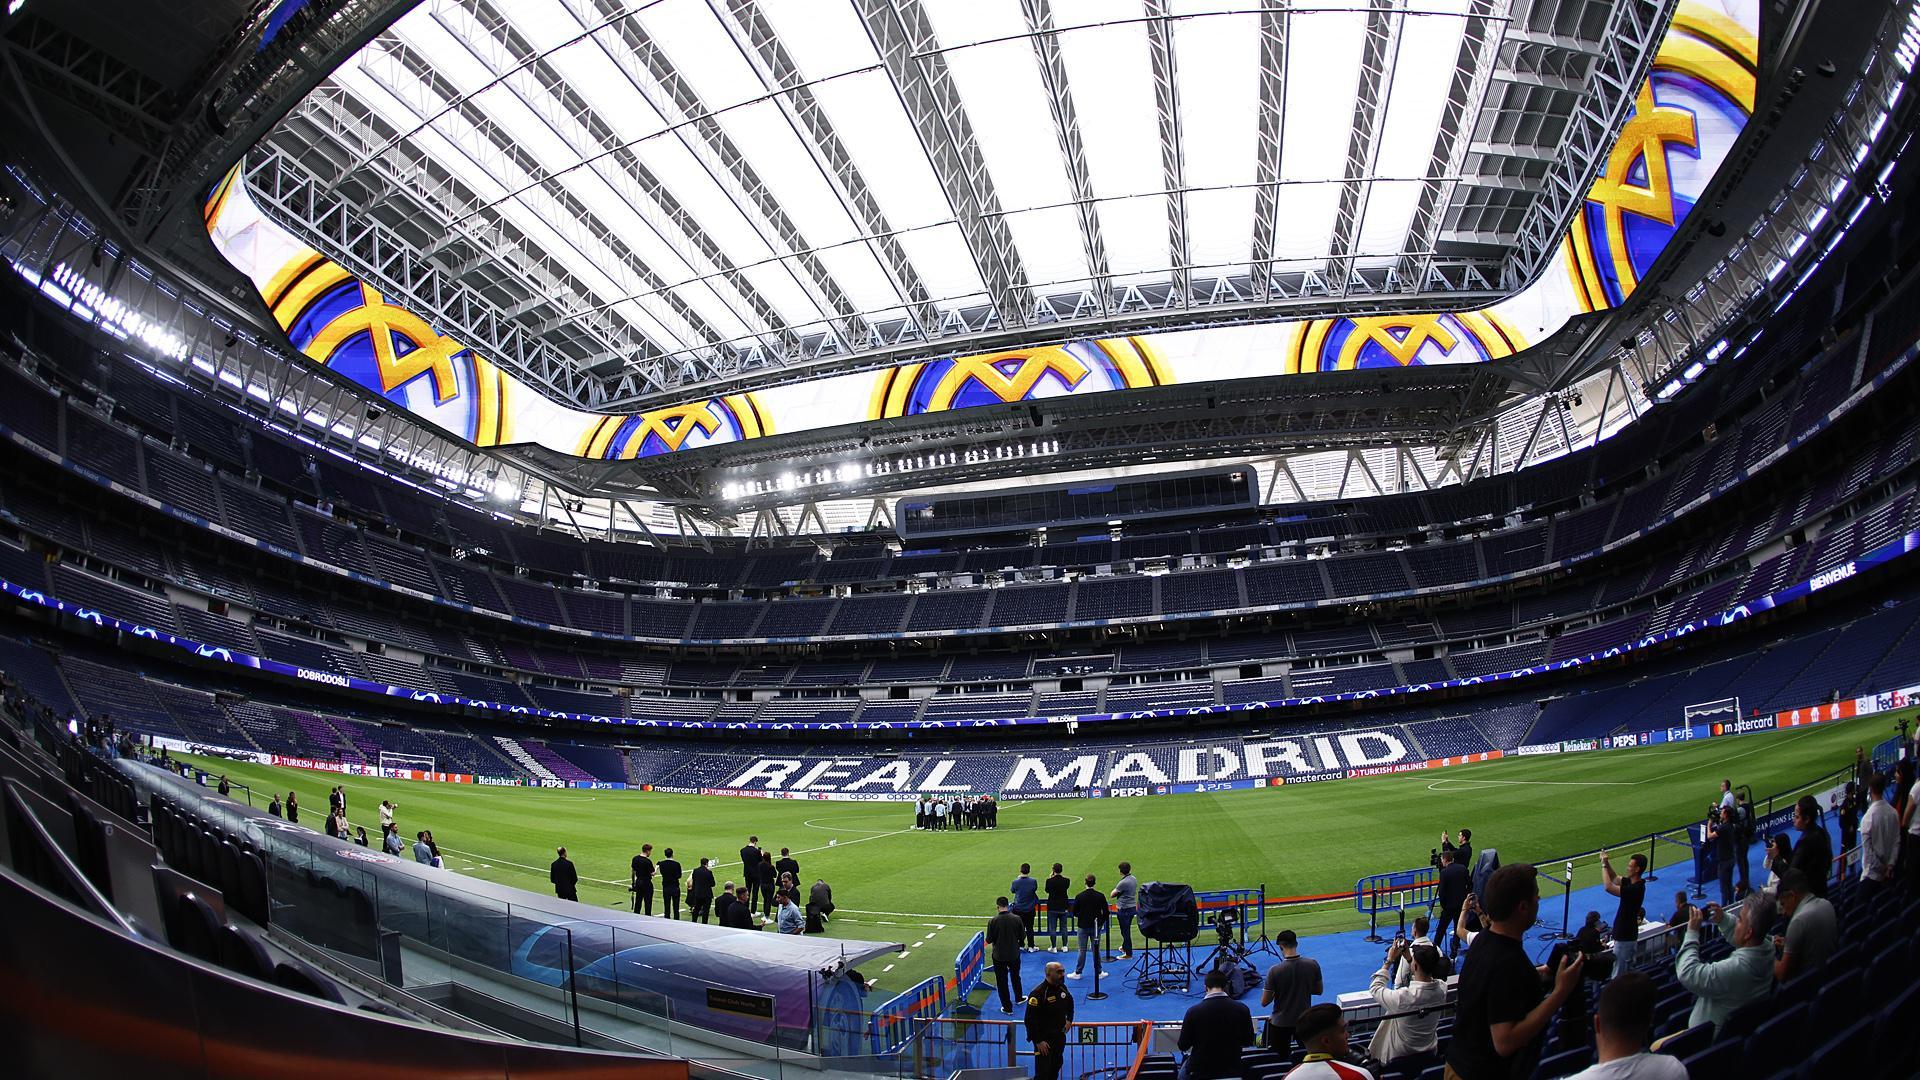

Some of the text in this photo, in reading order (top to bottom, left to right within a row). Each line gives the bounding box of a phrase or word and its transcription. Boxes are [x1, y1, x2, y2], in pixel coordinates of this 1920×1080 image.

[231, 531, 246, 542] Madrid
[278, 548, 292, 558] Madrid
[323, 563, 338, 573] Madrid
[367, 577, 381, 586] Madrid
[1809, 562, 1857, 591] BIENVENUE
[297, 668, 350, 687] DOBRODOŠLI
[1876, 690, 1906, 711] FedEx
[1047, 715, 1078, 723] WELCOME
[1564, 740, 1592, 752] Heineken
[1613, 734, 1638, 748] PEPSI
[282, 757, 345, 772] TURKISH AIRLINES
[727, 731, 1407, 792] REAL MADRID
[349, 765, 371, 776] FedEx
[383, 768, 405, 779] FedEx
[1360, 761, 1428, 776] TURKISH AIRLINES
[478, 776, 515, 786] Heineken
[1286, 771, 1343, 785] mastercard
[541, 779, 566, 789] PEPSI
[654, 784, 698, 795] mastercard
[1207, 782, 1232, 790] PS5
[711, 789, 767, 798] TURKISH AIRLINES
[773, 791, 794, 799] FedEx
[807, 792, 829, 800] FedEx
[850, 793, 879, 801] oppo
[887, 793, 917, 801] oppo
[1057, 791, 1079, 799] LEAGUE
[1110, 786, 1148, 798] PEPSI
[1755, 814, 1787, 833] HAMPIONS
